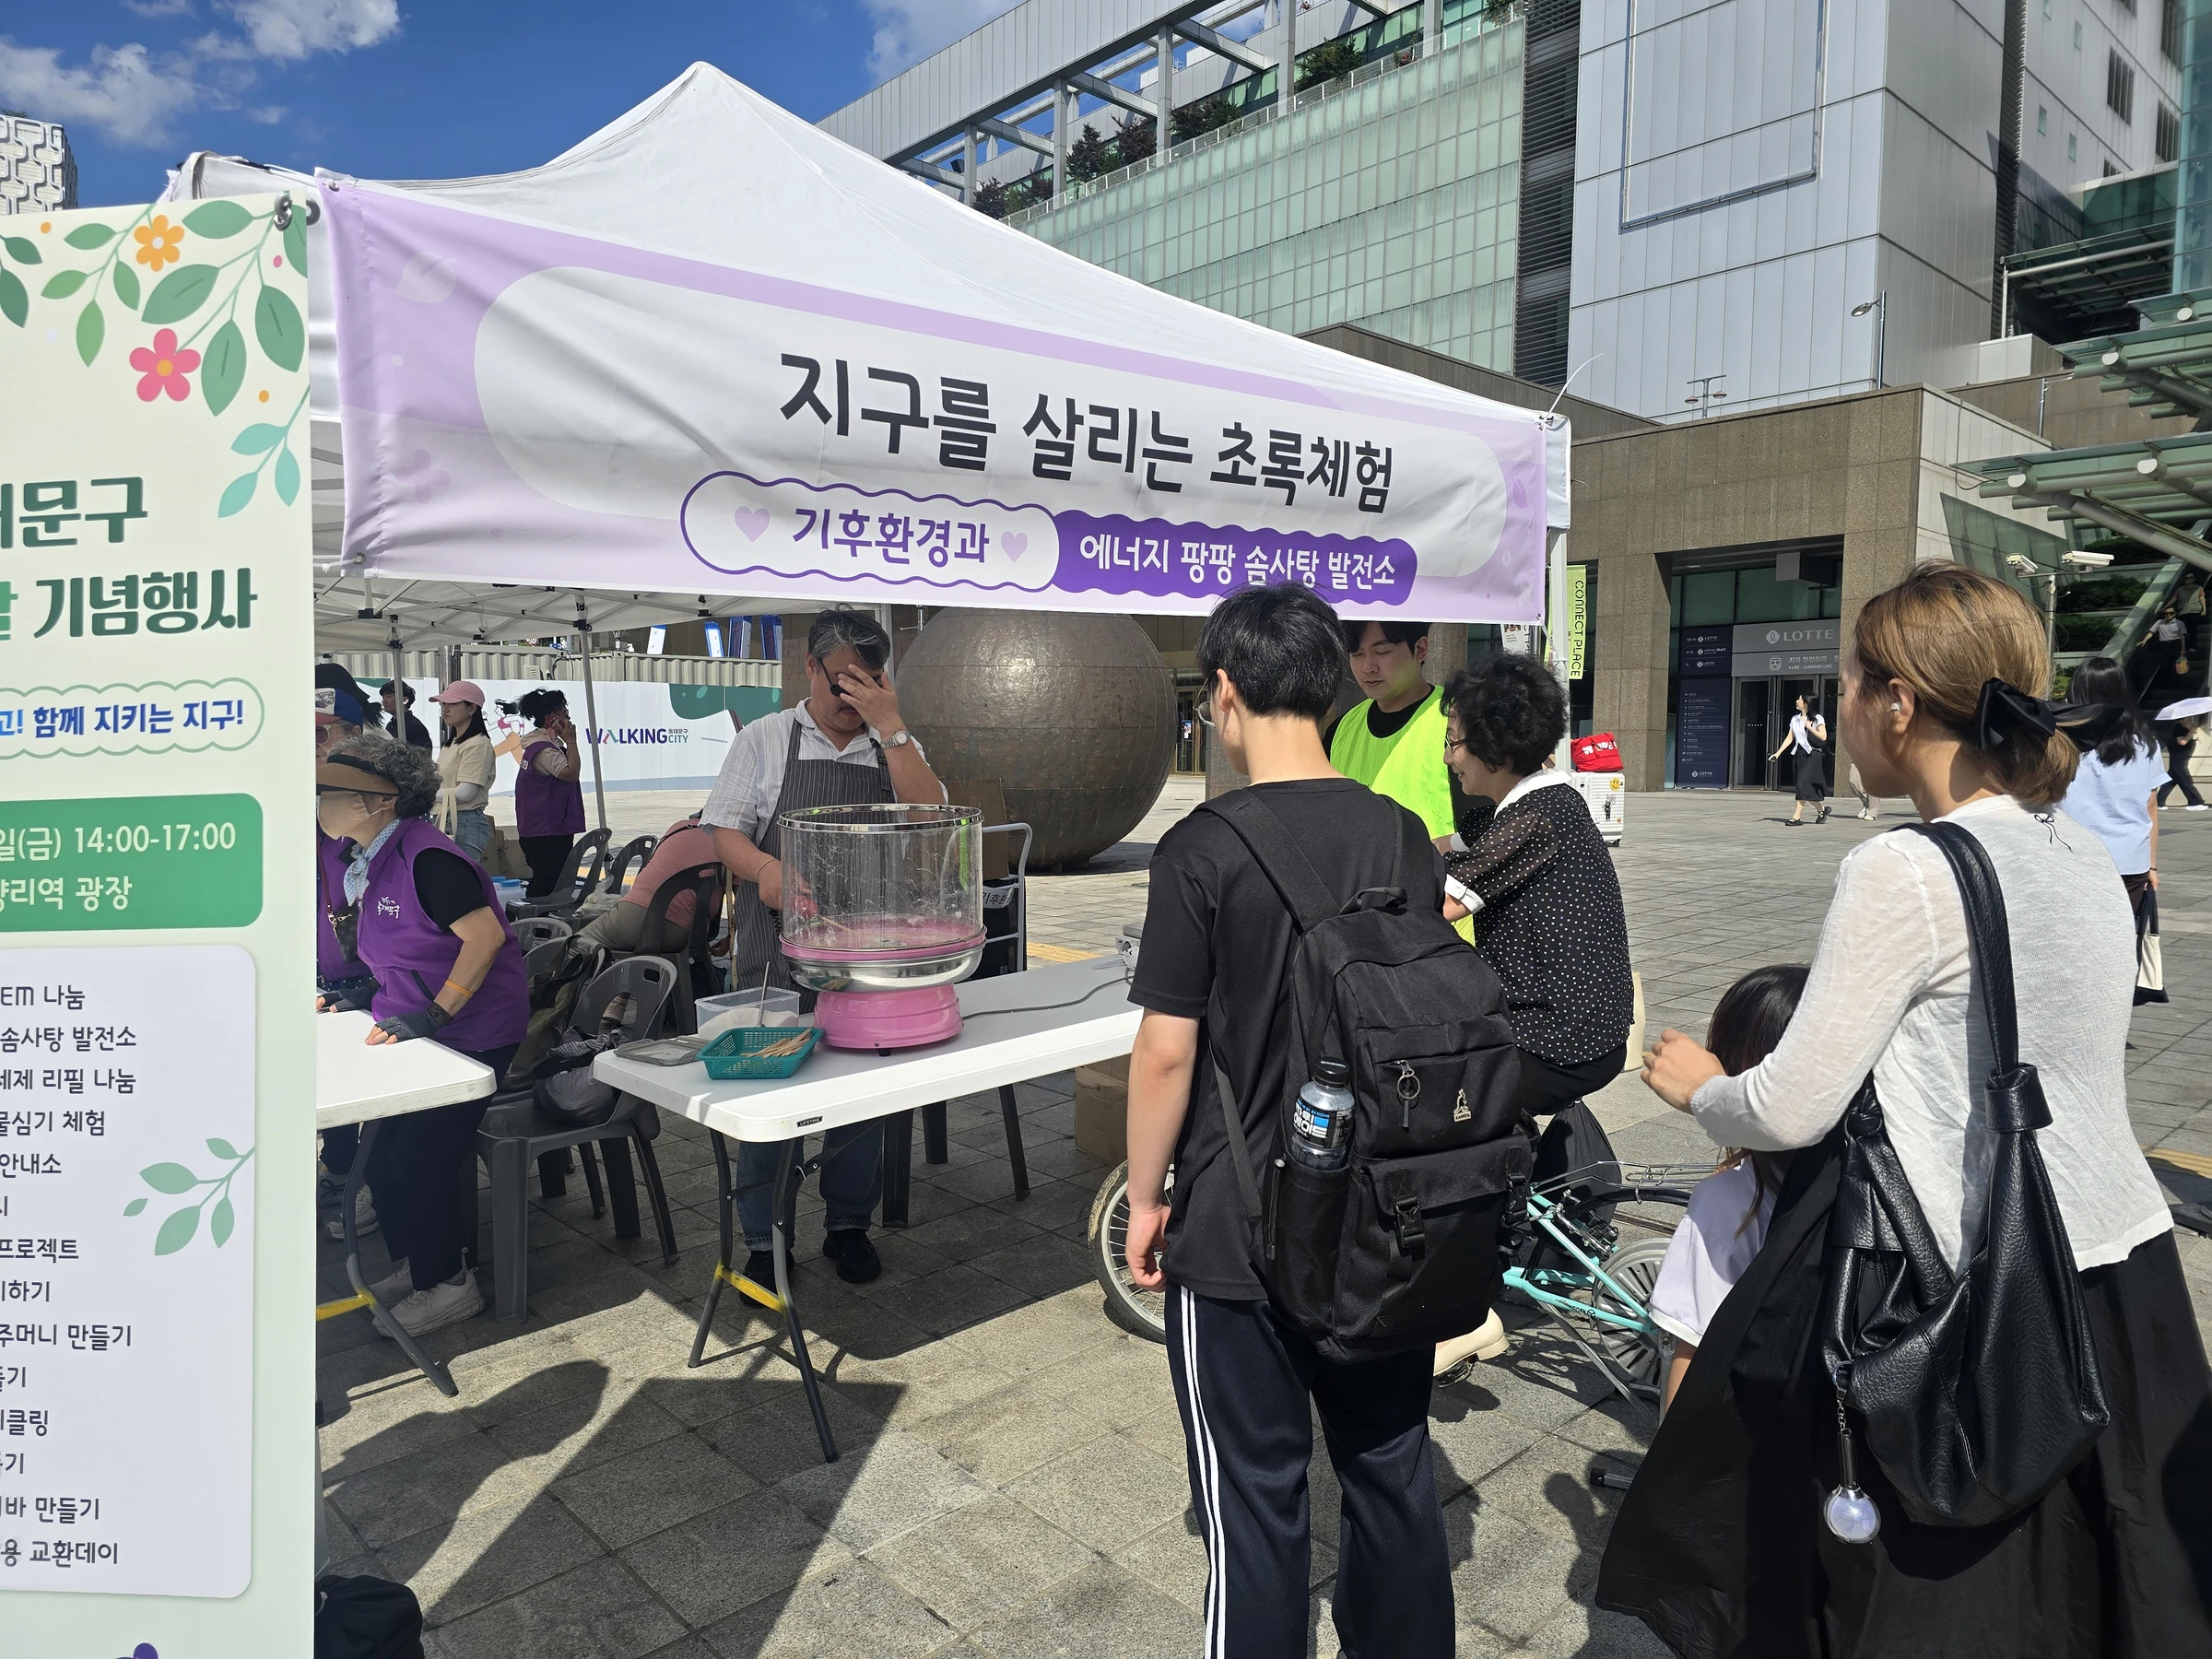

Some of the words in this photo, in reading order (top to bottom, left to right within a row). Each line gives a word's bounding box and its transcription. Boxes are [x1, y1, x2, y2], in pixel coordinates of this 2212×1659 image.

[780, 353, 996, 471] 지구를
[1022, 393, 1194, 493] 살리는
[1210, 421, 1393, 513] 초록체험
[0, 477, 148, 549] 문구
[793, 508, 990, 568] 기후환경과
[1079, 533, 1169, 573] 에너지
[1181, 541, 1236, 584] 팡팡
[1244, 546, 1320, 589] 솜사탕
[1328, 552, 1396, 590] 발전소
[34, 568, 258, 639] 기념행사
[1784, 629, 1834, 641] LOTTE
[1571, 639, 1583, 677] PLACE
[33, 706, 85, 738] 함께
[93, 703, 174, 735] 지키는
[182, 700, 243, 731] 지구!
[585, 728, 667, 744] WALKING
[668, 735, 688, 744] CITY
[75, 821, 236, 853] 14:00-17:00
[76, 876, 133, 912] 광장
[43, 984, 86, 1010] 나눔
[0, 1027, 65, 1053] 솜사탕
[73, 1026, 137, 1053] 발전소
[42, 1068, 84, 1095] 리필
[94, 1068, 136, 1094] 나눔
[63, 1109, 105, 1136] 체험
[0, 1279, 50, 1302] 하기
[67, 1324, 131, 1351] 만들기
[0, 1366, 26, 1393] 기
[0, 1409, 48, 1437] 클링
[0, 1453, 24, 1477] 기
[0, 1496, 27, 1518] 바
[35, 1497, 100, 1524] 만들기
[0, 1538, 22, 1568] 용
[29, 1539, 118, 1569] 교환데이
